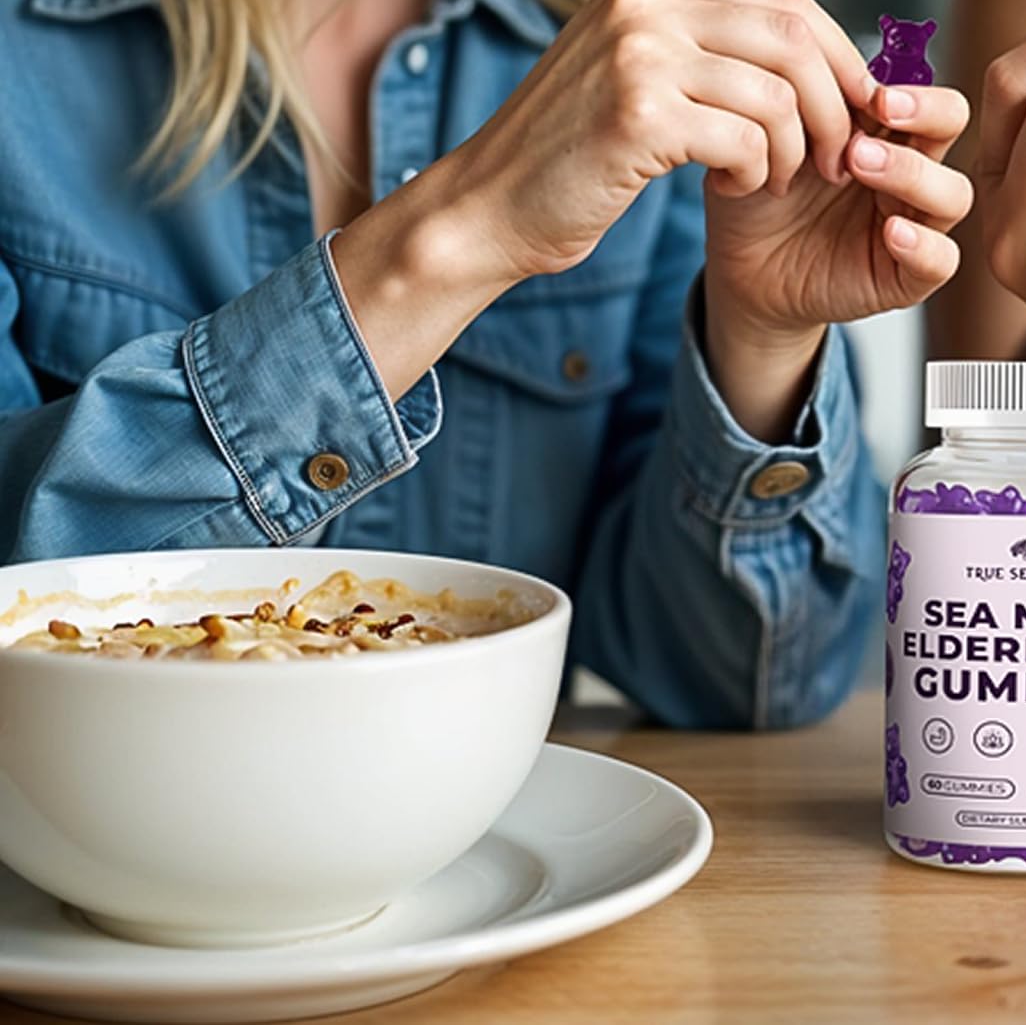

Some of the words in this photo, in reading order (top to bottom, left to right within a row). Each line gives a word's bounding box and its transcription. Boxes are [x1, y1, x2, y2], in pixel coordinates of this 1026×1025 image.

[966, 567, 1004, 582] TRUE
[924, 600, 999, 629] SEA
[927, 780, 942, 791] 60
[943, 781, 1006, 795] GUMMIES
[961, 814, 1006, 824] DIETARY
